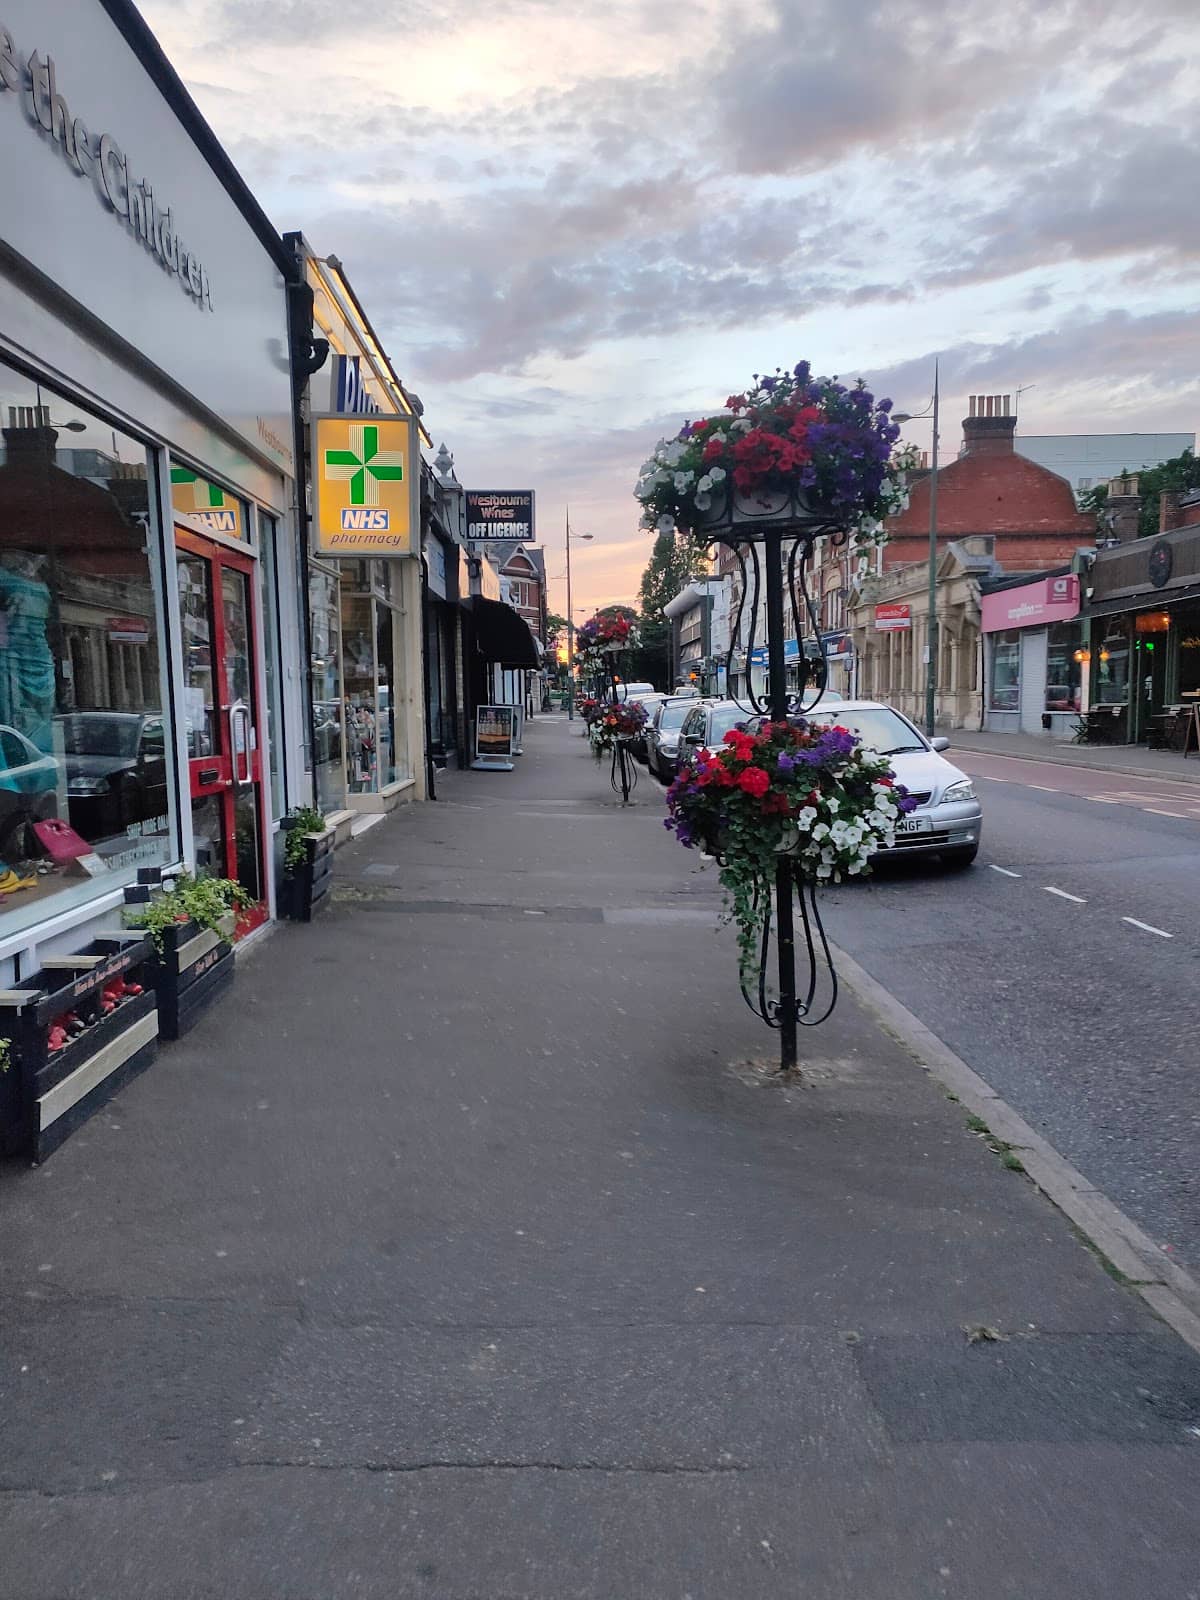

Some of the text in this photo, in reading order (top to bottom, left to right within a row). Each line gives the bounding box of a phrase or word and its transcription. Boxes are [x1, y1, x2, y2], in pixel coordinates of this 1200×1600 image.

[28, 49, 213, 312] the Children
[468, 494, 530, 506] Westbourne
[480, 506, 514, 518] Wines
[343, 510, 387, 529] NHS
[468, 522, 529, 537] OFF LICENCE
[330, 532, 402, 546] pharmacy
